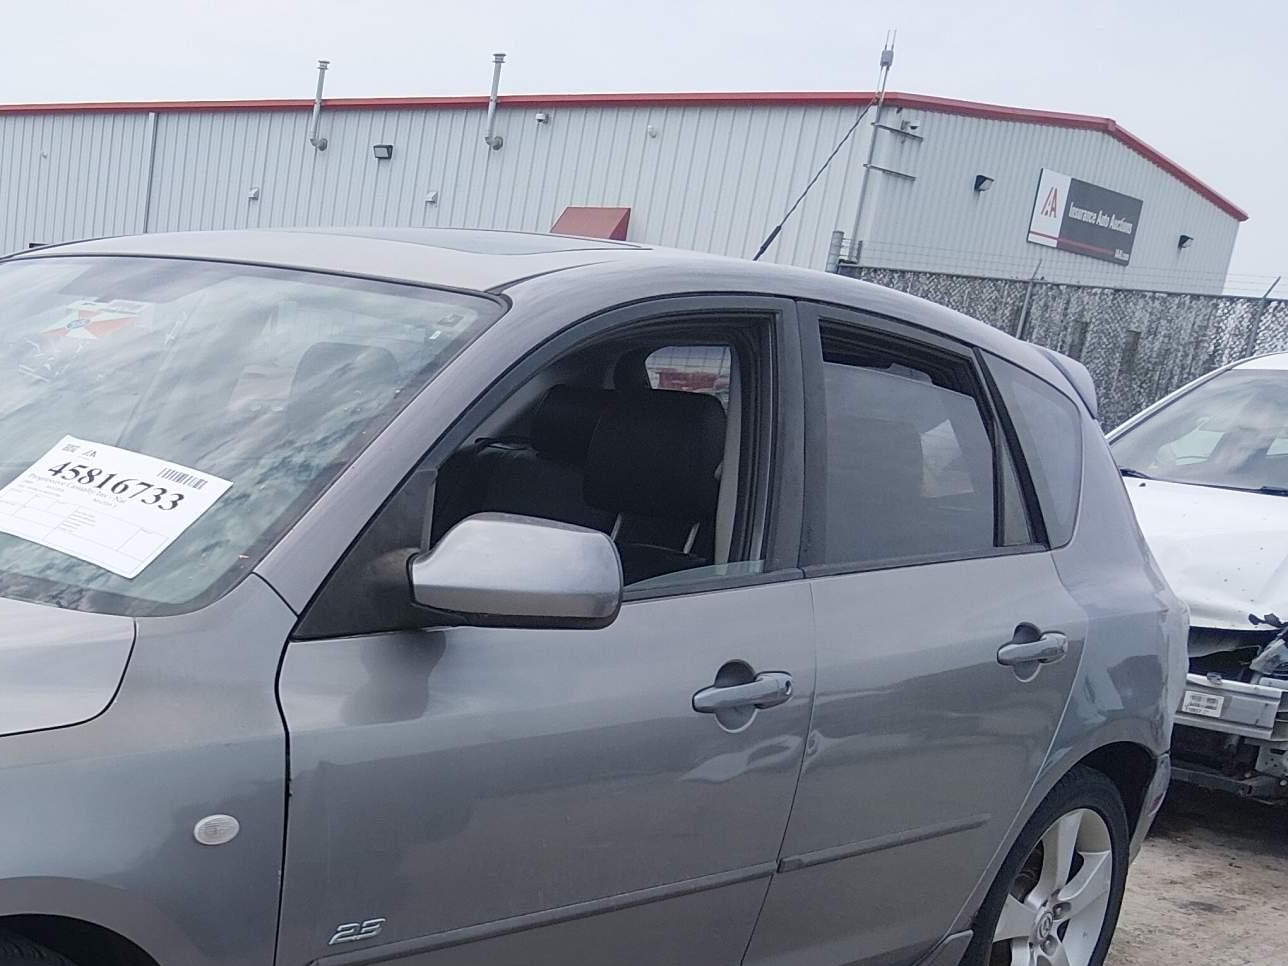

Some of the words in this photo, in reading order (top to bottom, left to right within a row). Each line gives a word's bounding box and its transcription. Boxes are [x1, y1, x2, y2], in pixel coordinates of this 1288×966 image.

[1068, 201, 1097, 224] Insurance
[1096, 210, 1110, 228] Auto
[47, 461, 185, 511] 45816733
